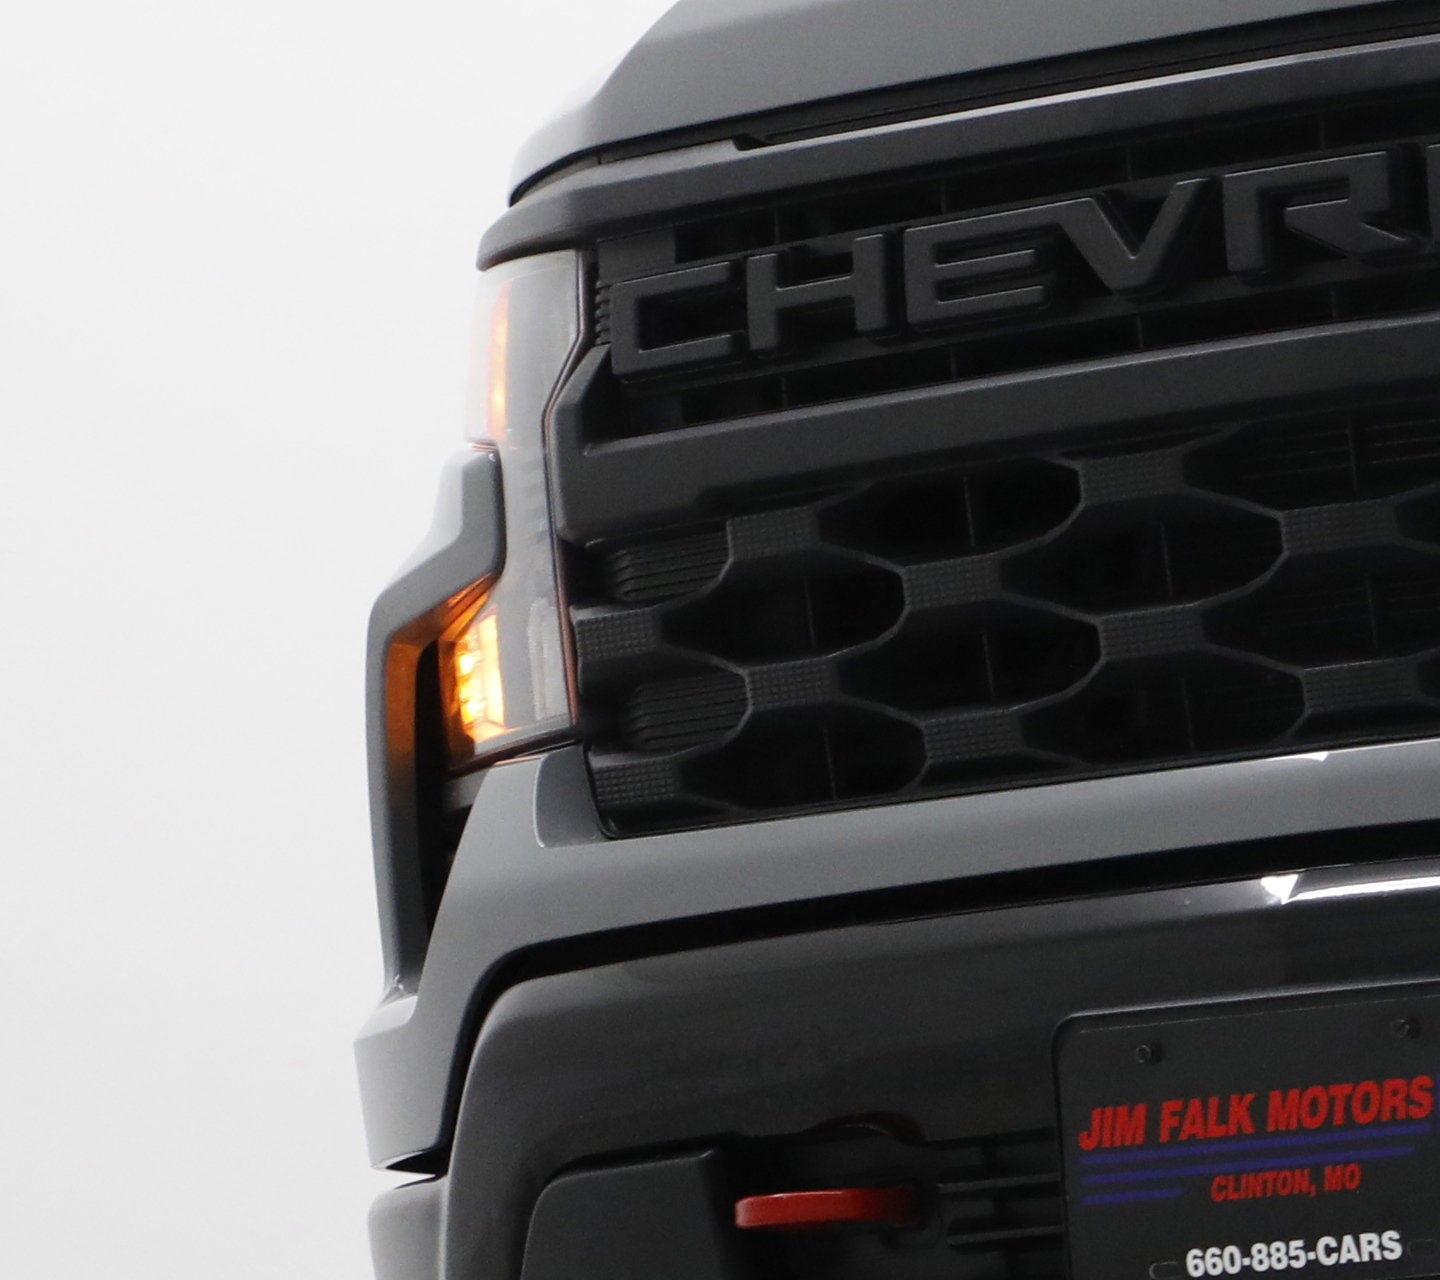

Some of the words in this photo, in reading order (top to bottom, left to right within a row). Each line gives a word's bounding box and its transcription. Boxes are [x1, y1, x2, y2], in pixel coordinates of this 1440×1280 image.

[1078, 1103, 1148, 1151] JIM
[1158, 1093, 1256, 1143] FALK
[1266, 1074, 1435, 1132] MOTORS
[1210, 1168, 1318, 1202] CLINTON,
[1323, 1163, 1362, 1192] MO
[1185, 1230, 1403, 1278] 660-885-CARS
